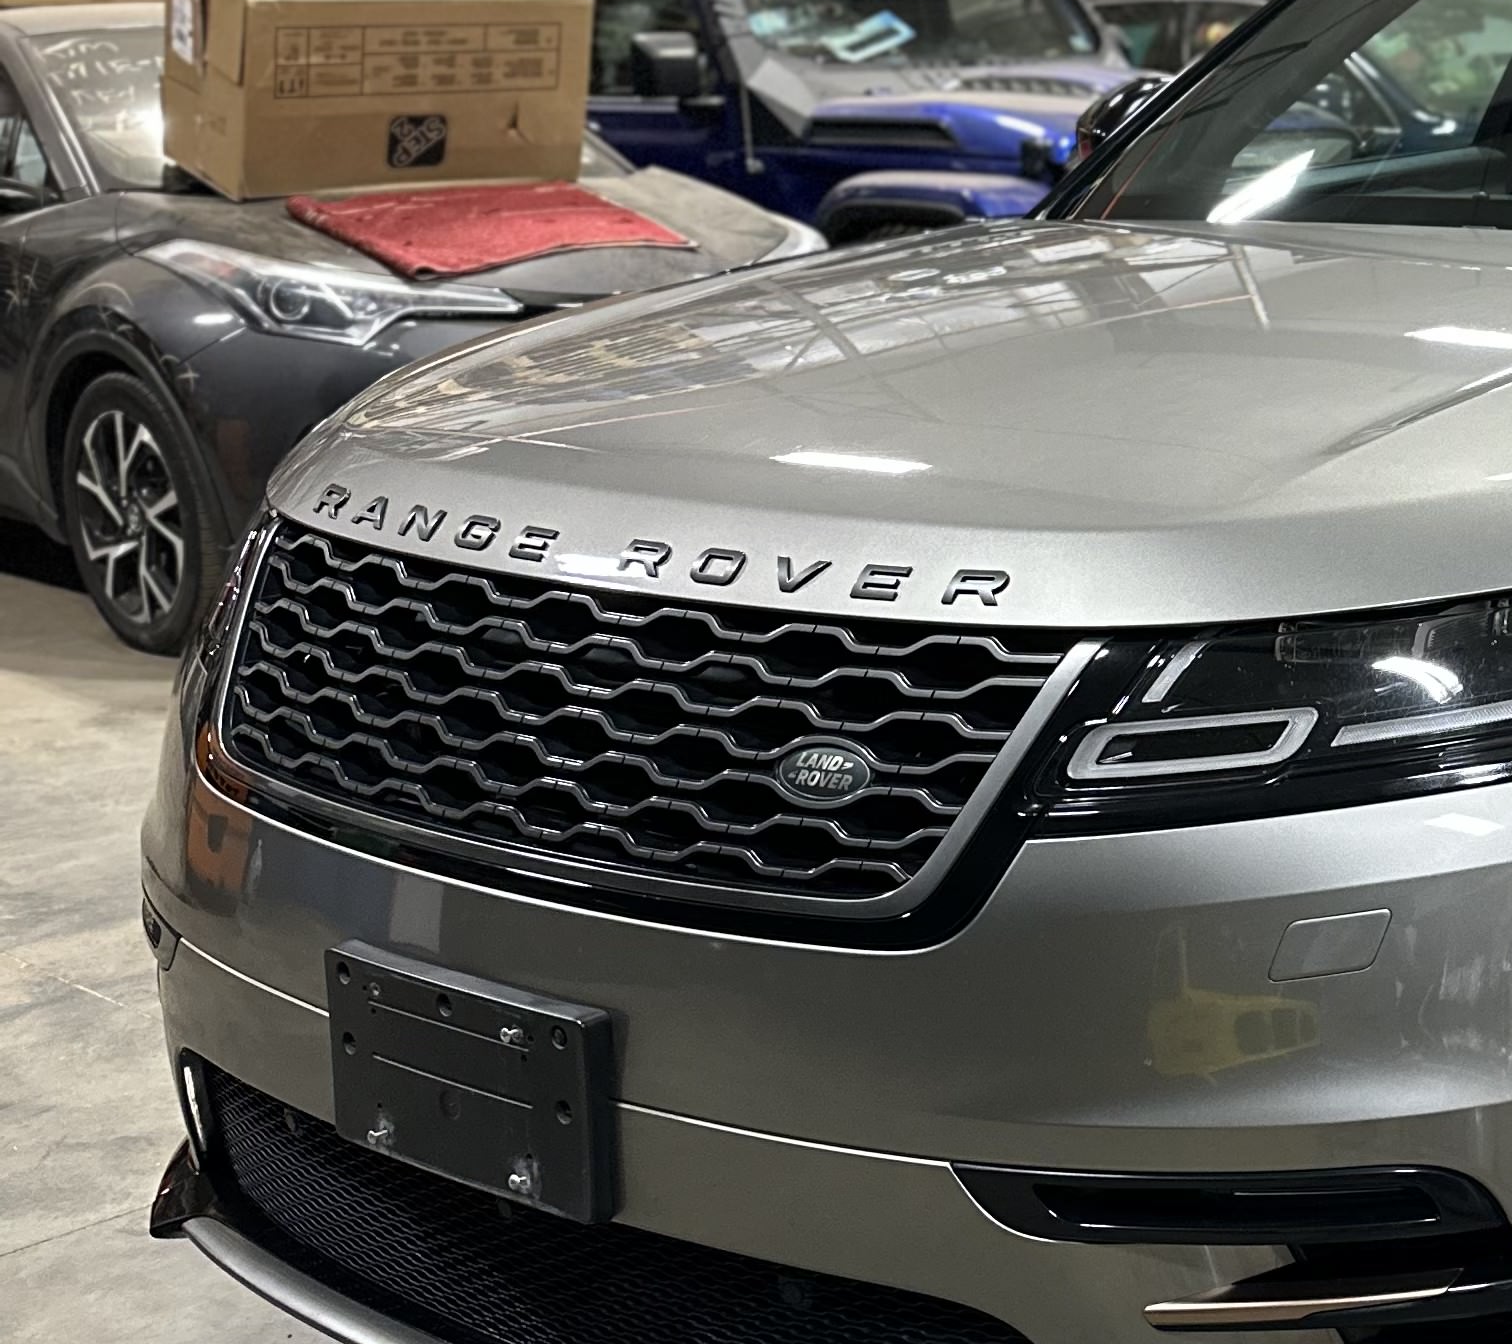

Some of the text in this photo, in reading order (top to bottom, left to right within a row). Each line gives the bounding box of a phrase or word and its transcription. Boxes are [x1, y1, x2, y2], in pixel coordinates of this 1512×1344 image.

[392, 117, 446, 167] STEP
[313, 482, 1013, 607] RANGE ROVER
[796, 751, 845, 771] LAND
[795, 770, 853, 790] ROVER
